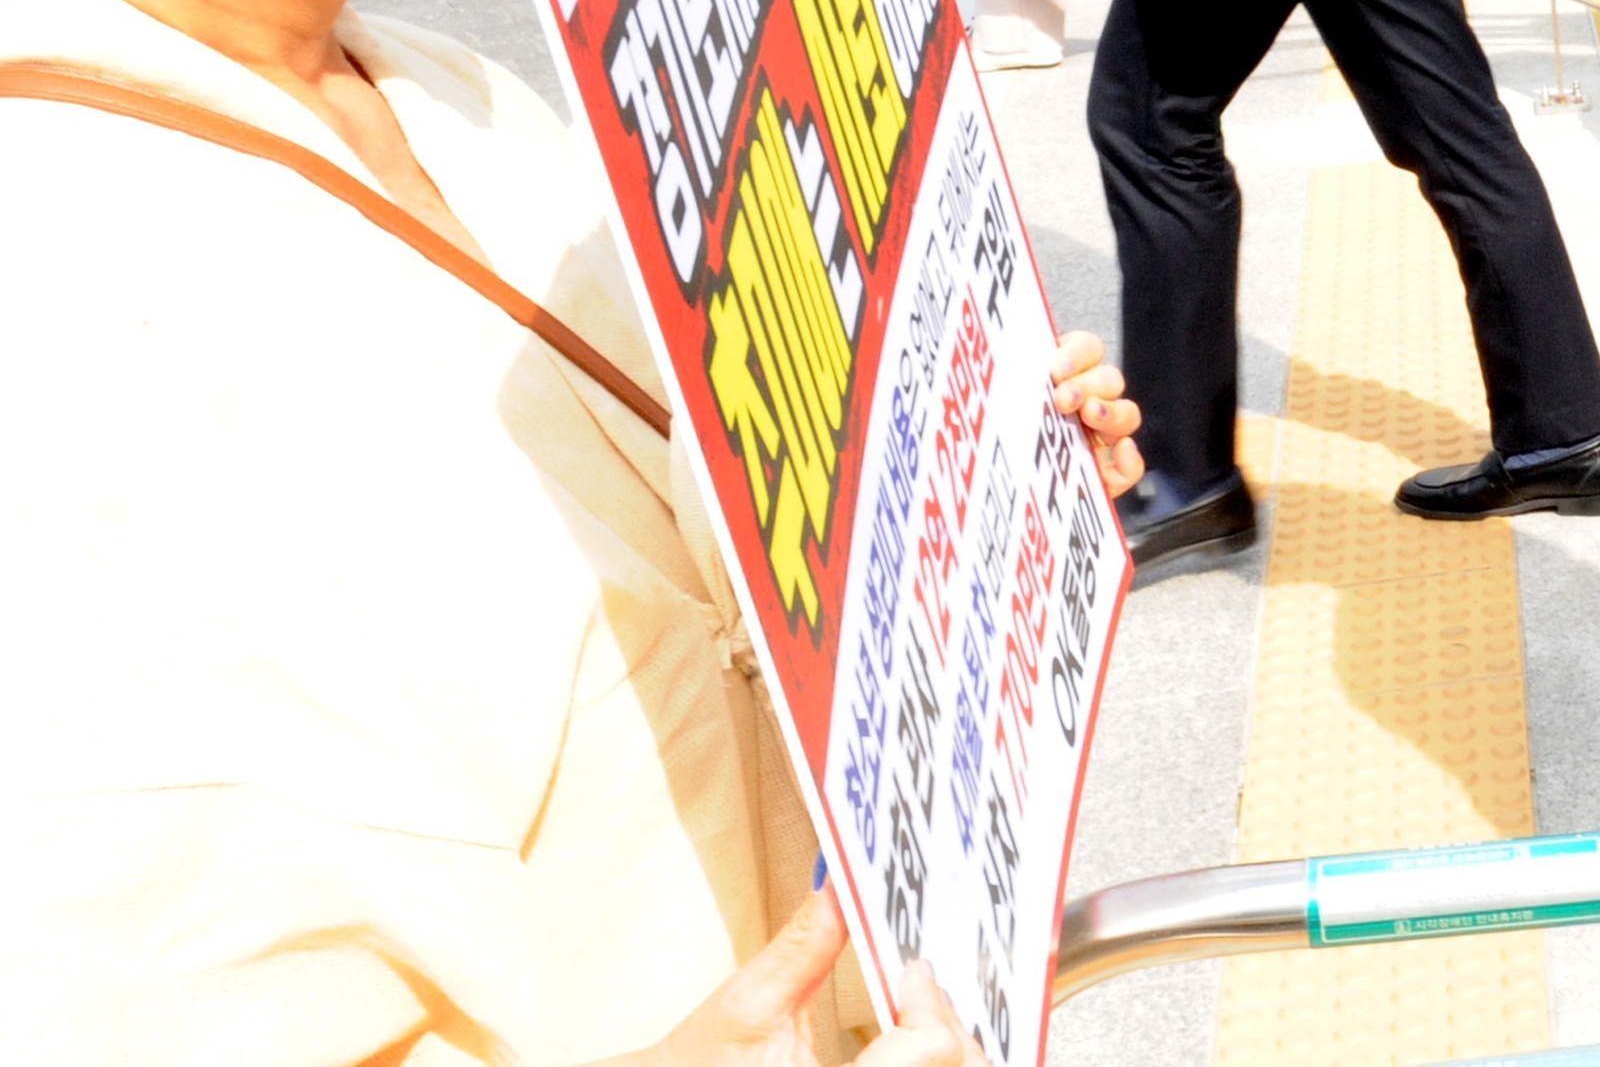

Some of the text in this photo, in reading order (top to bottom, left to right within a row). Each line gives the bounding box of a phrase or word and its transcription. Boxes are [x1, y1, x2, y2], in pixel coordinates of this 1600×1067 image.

[710, 88, 862, 626] 추미애는
[845, 634, 885, 864] 청소년
[865, 477, 905, 678] 생리대
[885, 349, 926, 522] 비용은
[938, 110, 985, 258] 뒤에서는
[884, 181, 1016, 960] 호화 관사 12억 2천만원 구입!
[951, 438, 1016, 853] 4개월 된 차 버리고
[995, 487, 1054, 813] 7,700만원
[1052, 467, 1104, 747] OK돌멩이
[984, 770, 1020, 974] 신차
